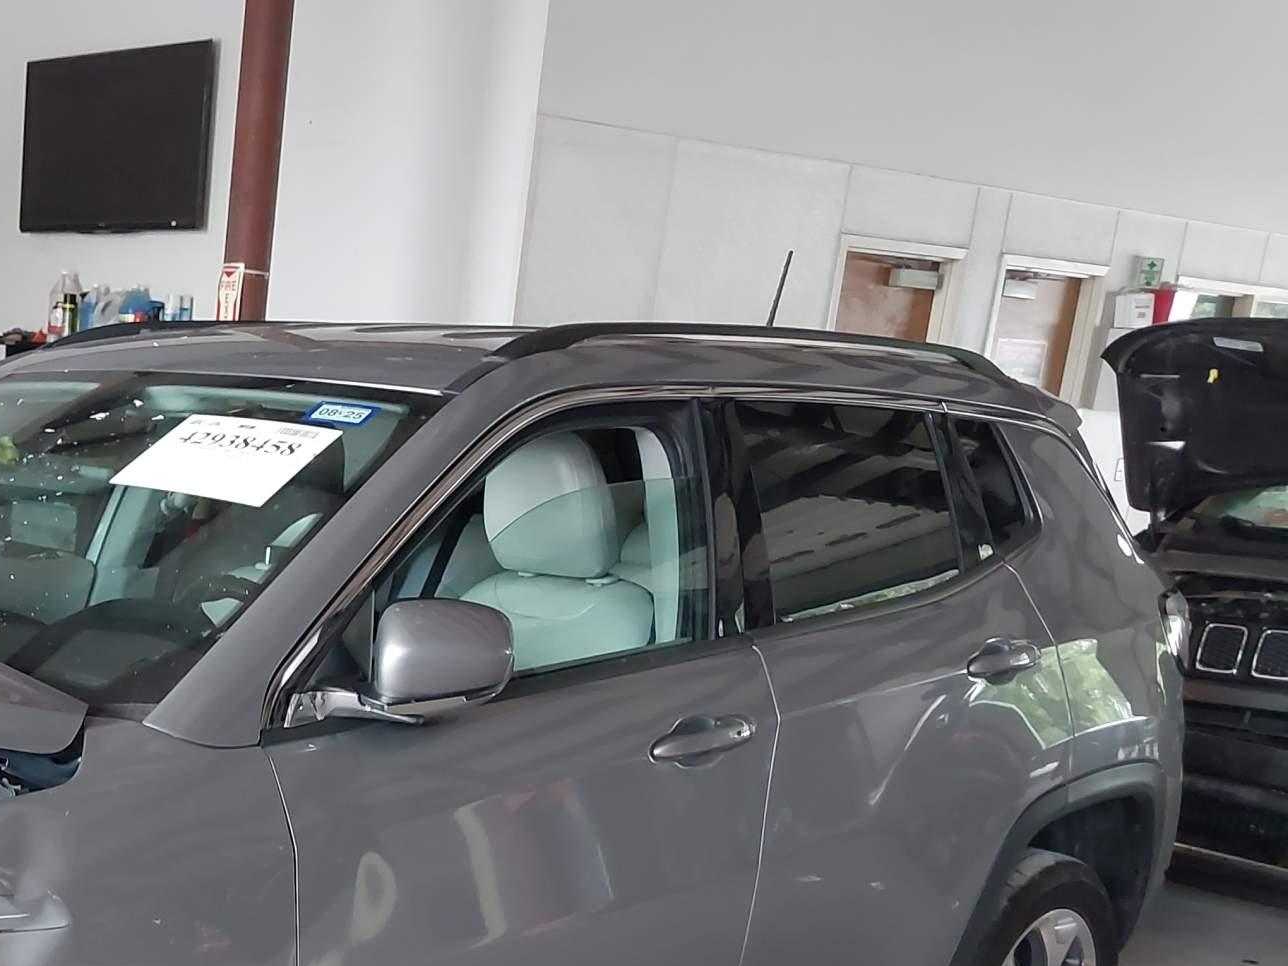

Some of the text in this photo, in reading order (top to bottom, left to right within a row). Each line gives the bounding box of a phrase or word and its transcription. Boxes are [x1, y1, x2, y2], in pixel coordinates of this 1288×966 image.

[318, 408, 365, 420] 08 25
[180, 431, 302, 456] 42938458
